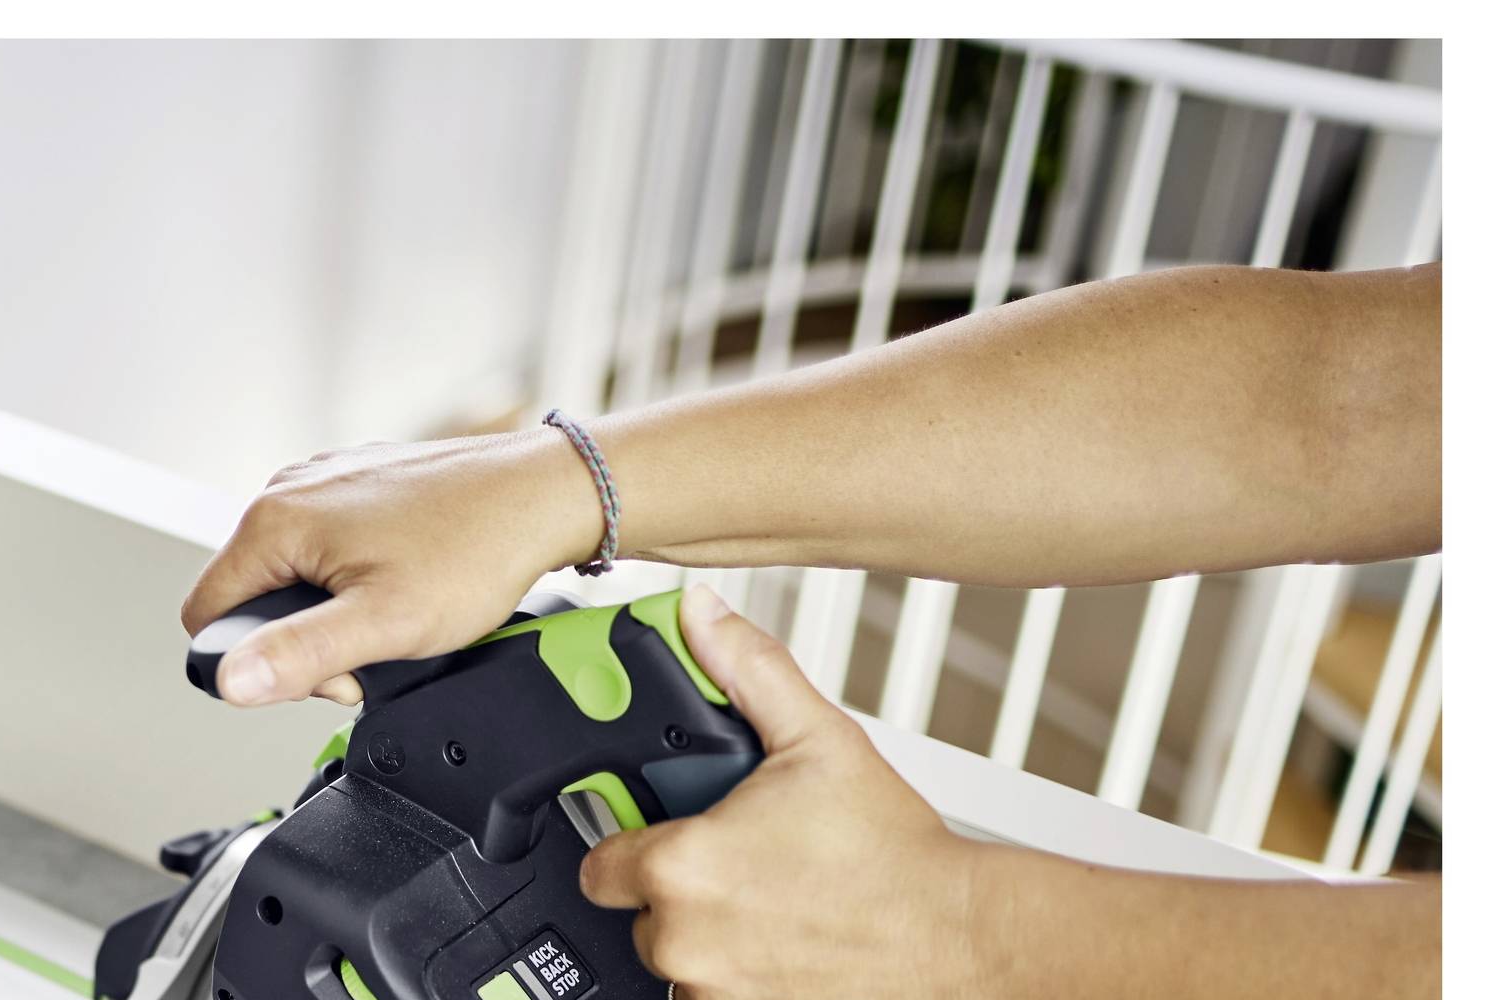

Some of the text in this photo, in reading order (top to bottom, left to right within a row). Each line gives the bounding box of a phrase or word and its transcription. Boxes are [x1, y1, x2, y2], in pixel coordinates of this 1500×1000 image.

[528, 940, 560, 968] KICK
[540, 952, 574, 983] BACK
[552, 968, 580, 996] STOP
